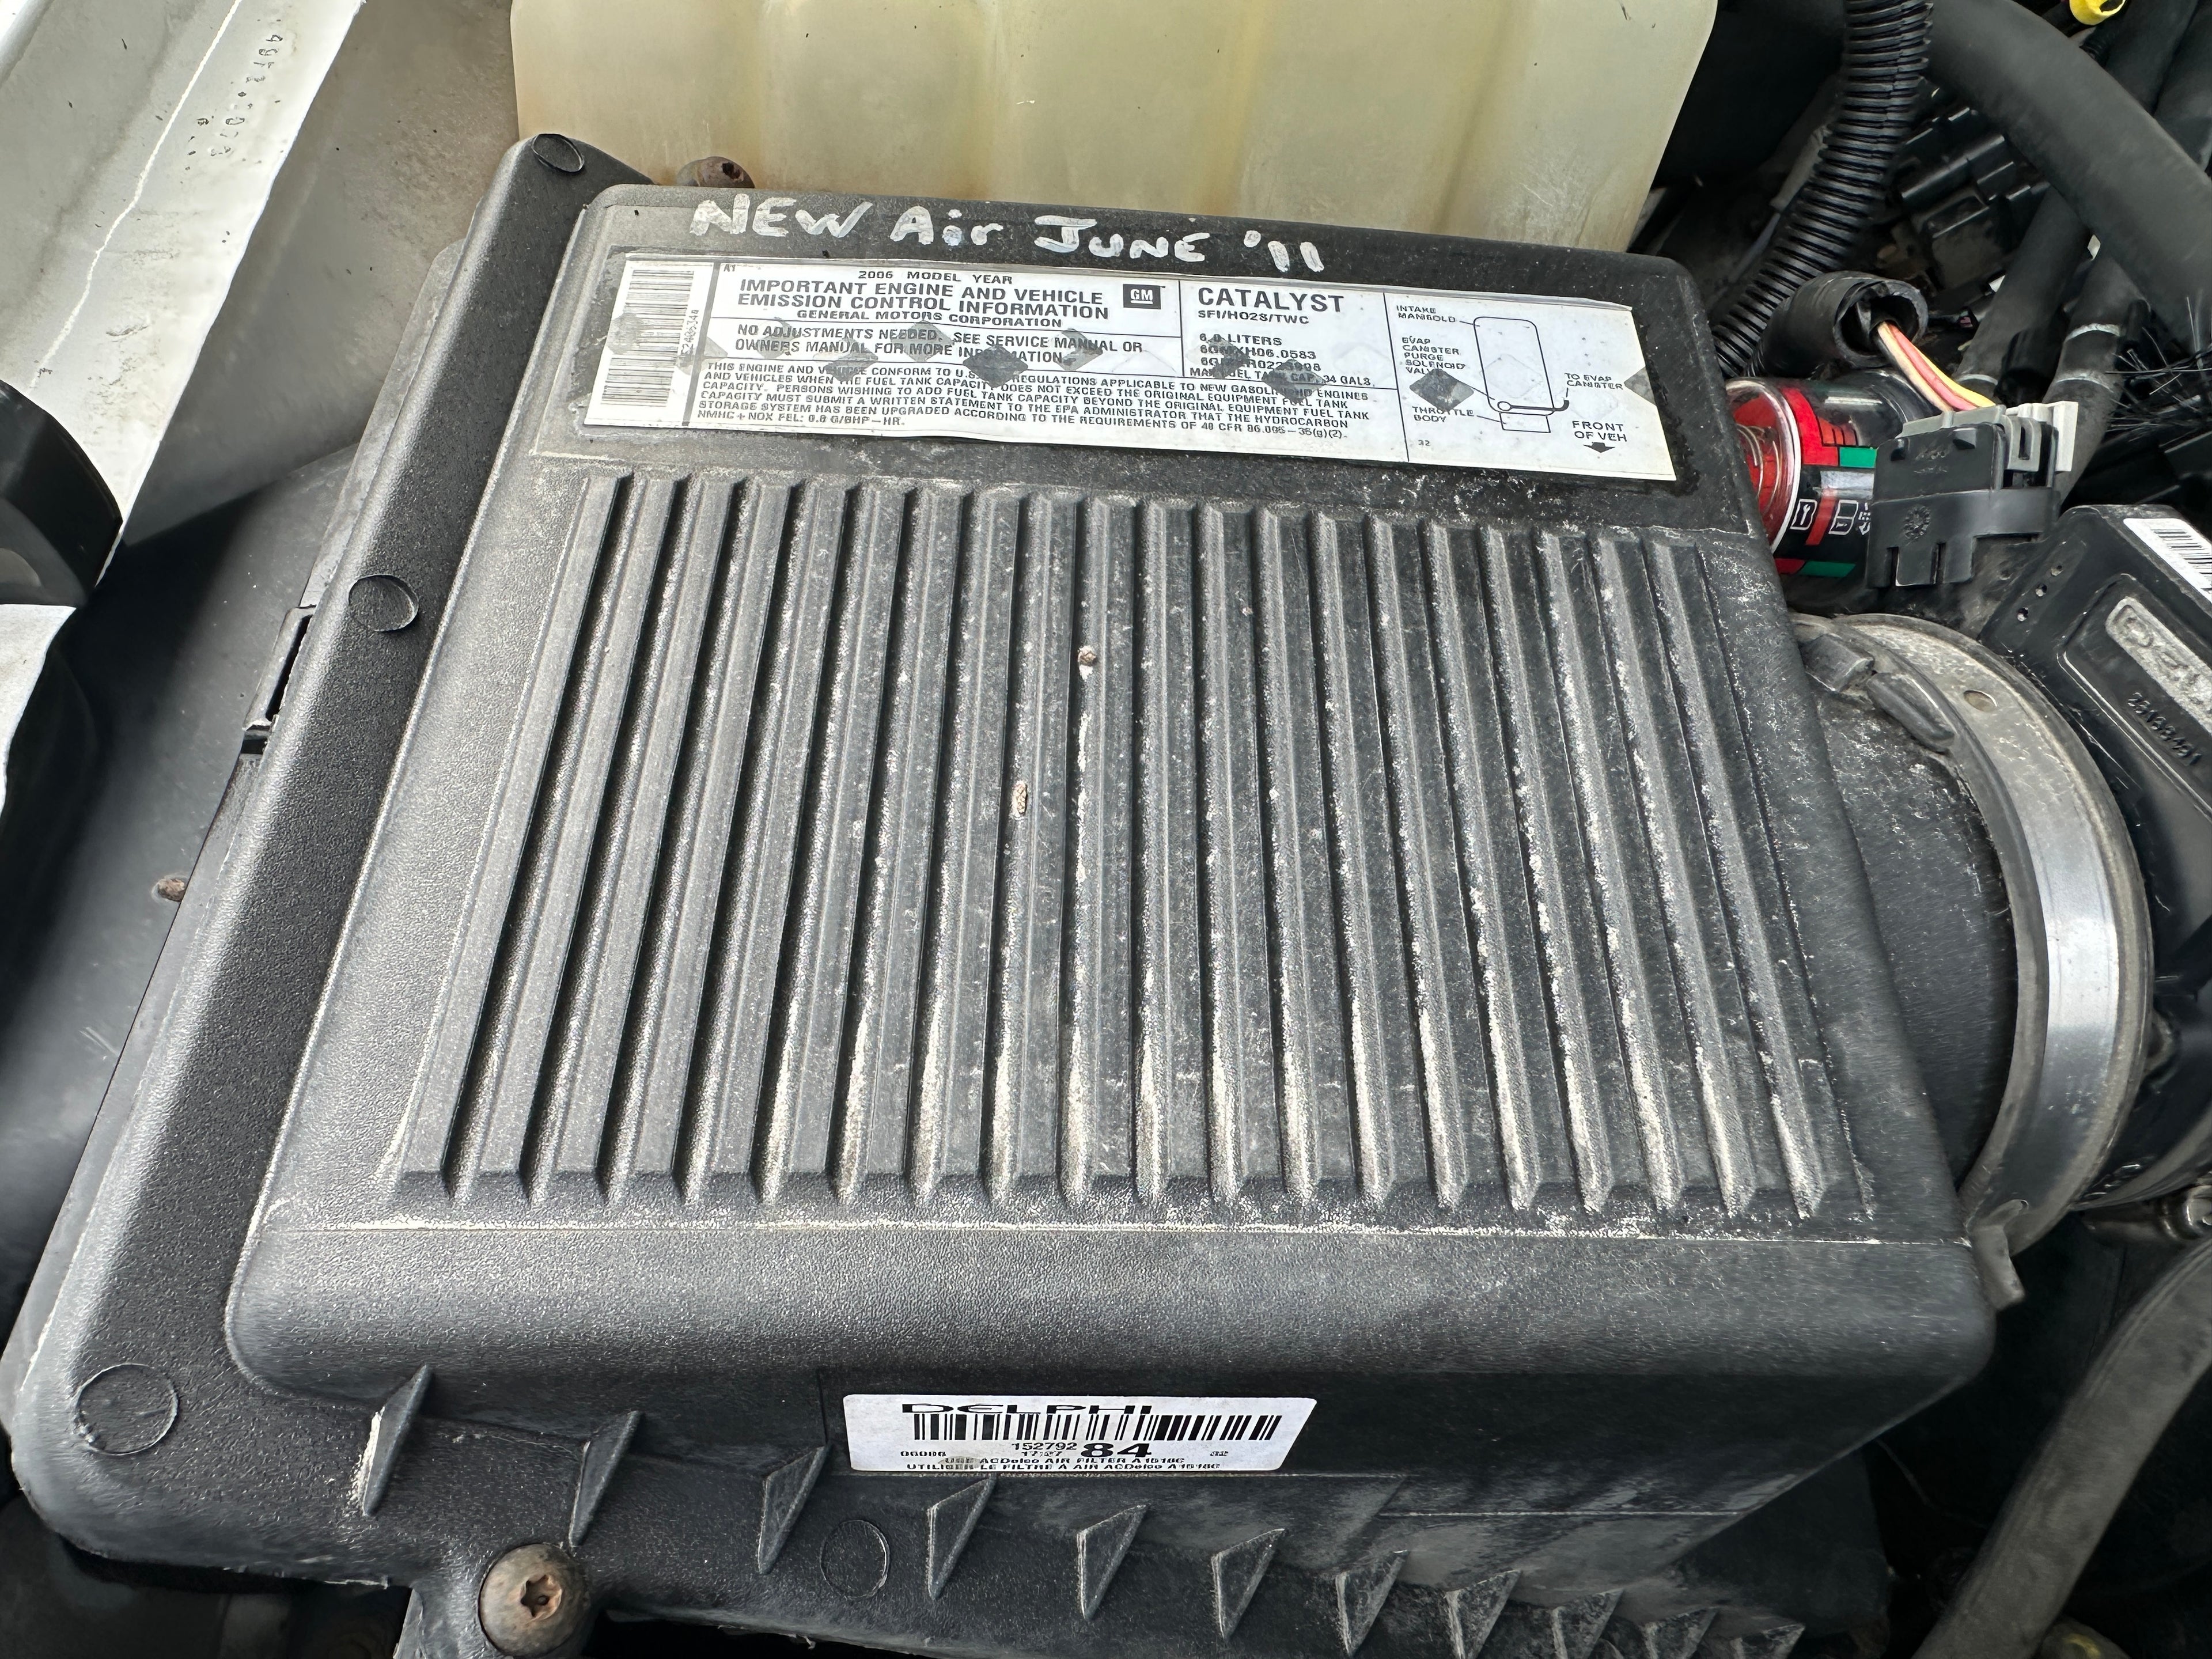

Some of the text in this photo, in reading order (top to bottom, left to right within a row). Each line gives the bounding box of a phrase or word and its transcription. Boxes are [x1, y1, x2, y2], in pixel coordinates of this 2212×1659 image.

[690, 194, 1324, 272] NEW Air JUNE '11
[858, 271, 1013, 285] 2006 MODEL YEAR
[740, 279, 1103, 305] IMPORTANT ENGINE AND VEHICLE
[1130, 289, 1153, 301] GM
[738, 293, 1109, 320] EMISSION CONTROL INFORMATION
[1198, 287, 1344, 313] CATALYST
[1396, 305, 1436, 314] INTAKE
[797, 310, 1062, 328] GENERAL MOTORS CORPORATION
[1198, 310, 1309, 325] SFI/HO2S/TWC
[1398, 312, 1456, 323] MANIFOLD
[738, 324, 759, 336] NO
[762, 325, 874, 340] ADJUSTMENTS
[953, 332, 981, 345] SEE
[986, 335, 1049, 349] SERVICE
[1054, 336, 1118, 352] MANUAL
[1123, 341, 1143, 353] OR
[1199, 333, 1282, 346] 6.0 LITERS
[1402, 336, 1431, 344] EVAP
[805, 341, 866, 355] MANUAL
[874, 342, 904, 355] FOR
[910, 343, 953, 357] MORE
[959, 347, 1063, 363] INFMATION
[1402, 344, 1460, 355] CANISTER
[1404, 352, 1444, 361] PURGE
[1405, 359, 1466, 370] SOLENOID
[709, 362, 735, 371] THIS
[739, 363, 784, 373] ENGINE
[787, 365, 814, 374] AND
[872, 367, 931, 376] CONFORM
[935, 368, 952, 377] TO
[1012, 374, 1097, 386] REGULATIONS
[1100, 378, 1176, 390] APPLICABLE
[1180, 382, 1195, 391] TO
[1200, 383, 1226, 392] NEW
[1317, 389, 1369, 400] ENGINES
[1566, 380, 1624, 390] CANISTER
[704, 372, 731, 380] AND
[736, 372, 793, 382] VEHICLES
[797, 375, 834, 385] WHEN
[866, 377, 896, 385] FUEL
[900, 377, 932, 385] TANK
[936, 378, 994, 391] CAPACIT
[1001, 384, 1033, 392] DOES
[1037, 385, 1061, 393] NOT
[1066, 386, 1112, 396] EXCEED
[1117, 389, 1140, 397] THE
[1145, 390, 1204, 401] ORIGINAL
[1208, 393, 1278, 404] EQUIPMENT
[1316, 399, 1348, 409] TANK
[777, 384, 834, 394] PERSONS
[838, 386, 892, 395] WISHING
[897, 387, 912, 395] TO
[916, 387, 942, 396] ADD
[946, 388, 977, 398] FUEL
[981, 391, 1013, 402] TANK
[1018, 393, 1079, 404] CAPACITY
[1084, 397, 1133, 407] BEYOND
[1138, 399, 1161, 408] THE
[1165, 401, 1224, 412] ORIGINAL
[1228, 404, 1298, 416] EQUIPMENT
[1303, 408, 1334, 418] FUEL
[1336, 410, 1370, 420] TANK
[698, 410, 735, 419] NMHC
[748, 412, 774, 422] NOX
[778, 413, 804, 422] FEL:
[699, 400, 757, 411] STORAGE
[760, 403, 812, 412] SYSTEM
[815, 404, 840, 414] HAS
[845, 406, 877, 415] BEEN
[881, 407, 950, 416] UPGRADED
[954, 408, 1027, 422] ACCORDING
[1032, 414, 1047, 422] TO
[1051, 414, 1075, 424] THE
[1080, 415, 1176, 429] REQUIREMENTS
[1180, 421, 1197, 430] OF
[1218, 423, 1243, 433] CFR
[700, 391, 763, 401] CAPACITY
[766, 393, 802, 403] MUST
[805, 395, 854, 404] SUBMIT
[870, 397, 926, 406] WRITTEN
[930, 397, 1003, 410] STATEMENT
[1007, 403, 1023, 412] TO
[1028, 404, 1051, 413] THE
[1055, 404, 1079, 414] EPA
[1084, 407, 1187, 420] ADMINISTRATOR
[1191, 412, 1222, 421] THAT
[1226, 413, 1251, 423] THE
[1255, 415, 1349, 429] HYDROCARBON
[1413, 414, 1447, 423] BODY
[1572, 421, 1624, 432] FRONT
[1574, 431, 1627, 442] OF VEH
[902, 1403, 1152, 1415] DELPHI
[1011, 1442, 1152, 1458] 152792 84
